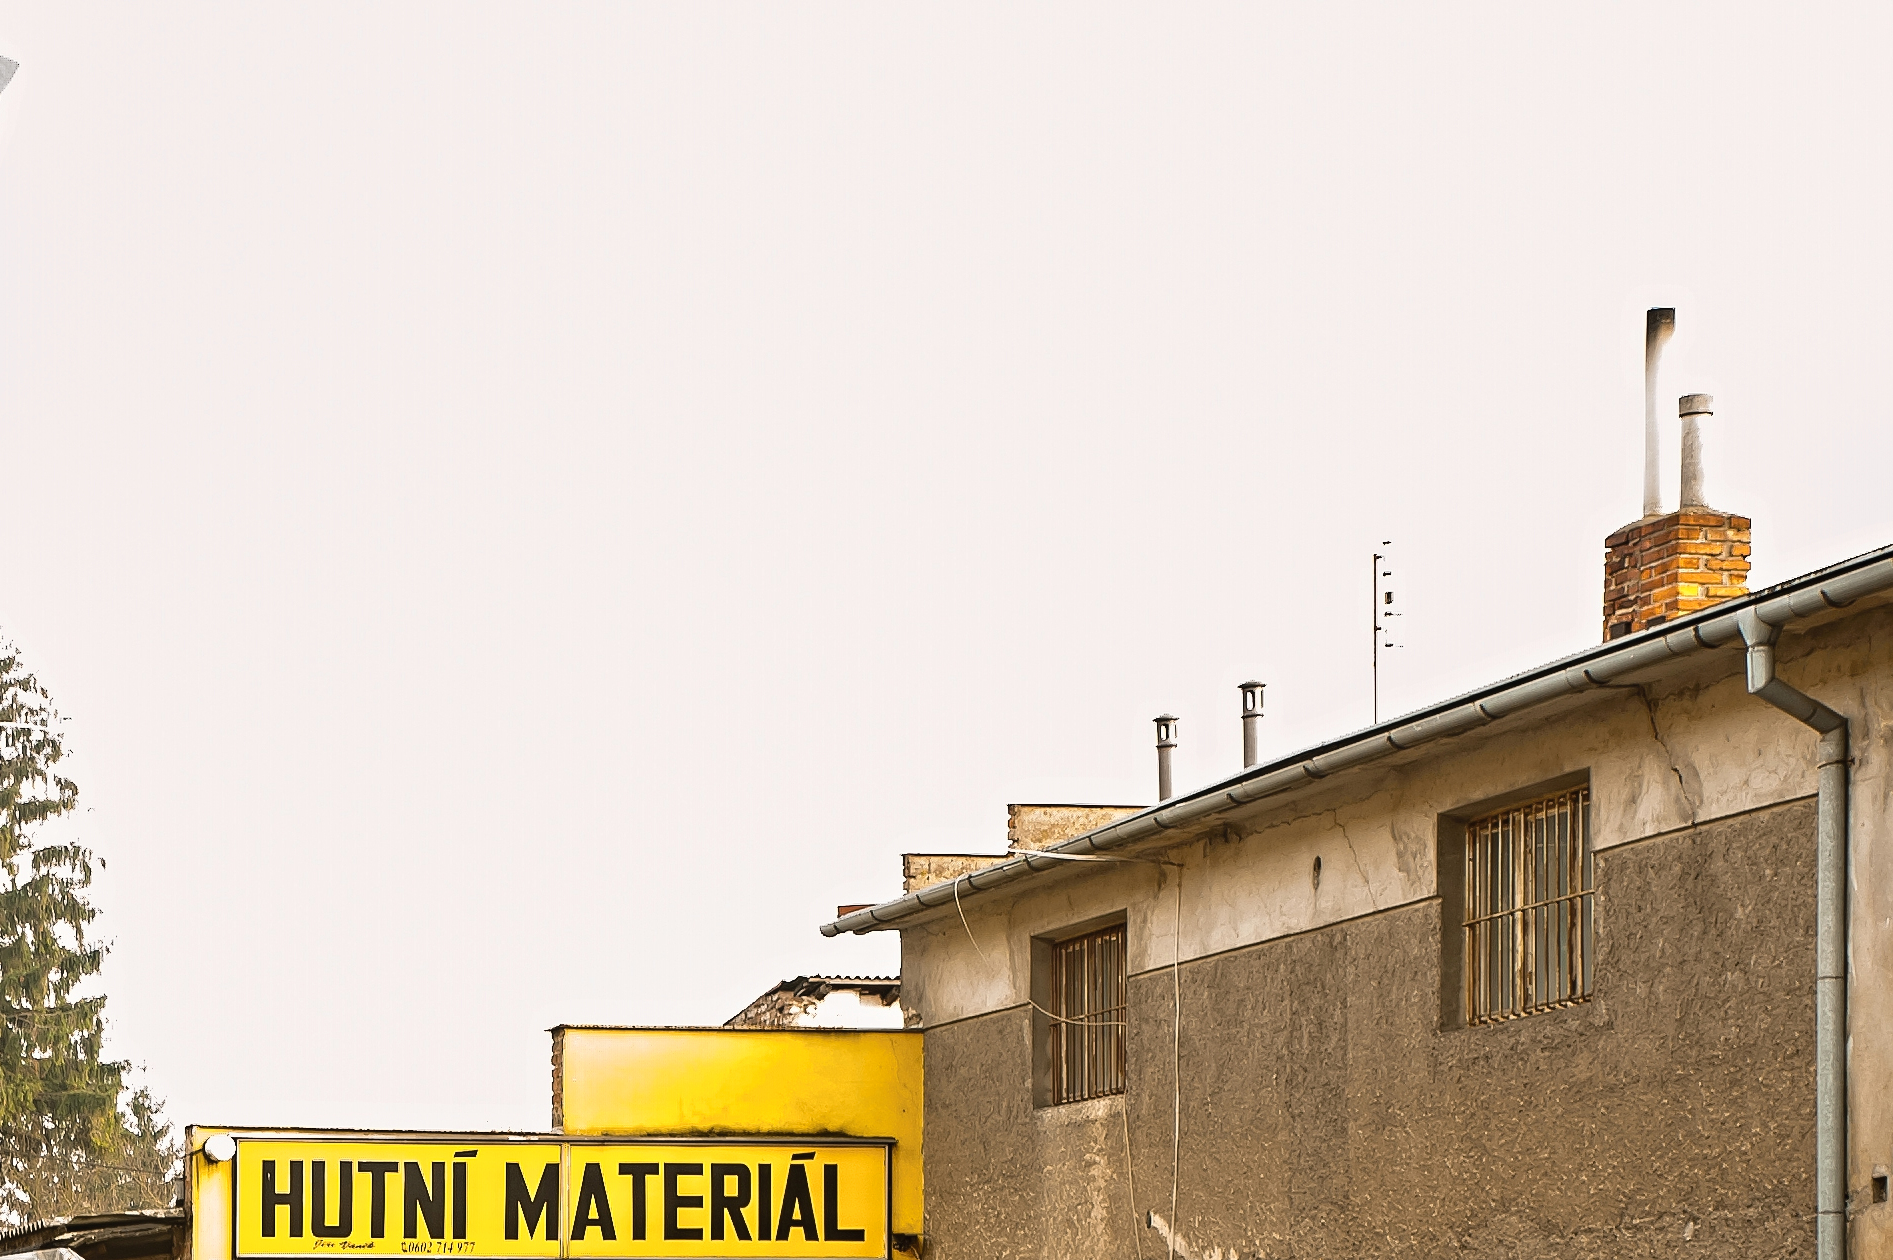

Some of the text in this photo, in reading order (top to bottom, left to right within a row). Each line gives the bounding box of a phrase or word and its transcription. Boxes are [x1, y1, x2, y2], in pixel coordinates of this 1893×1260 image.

[261, 1149, 866, 1242] HUTNÍ MATERIÁL
[436, 1241, 454, 1253] 714
[457, 1241, 476, 1253] 977
